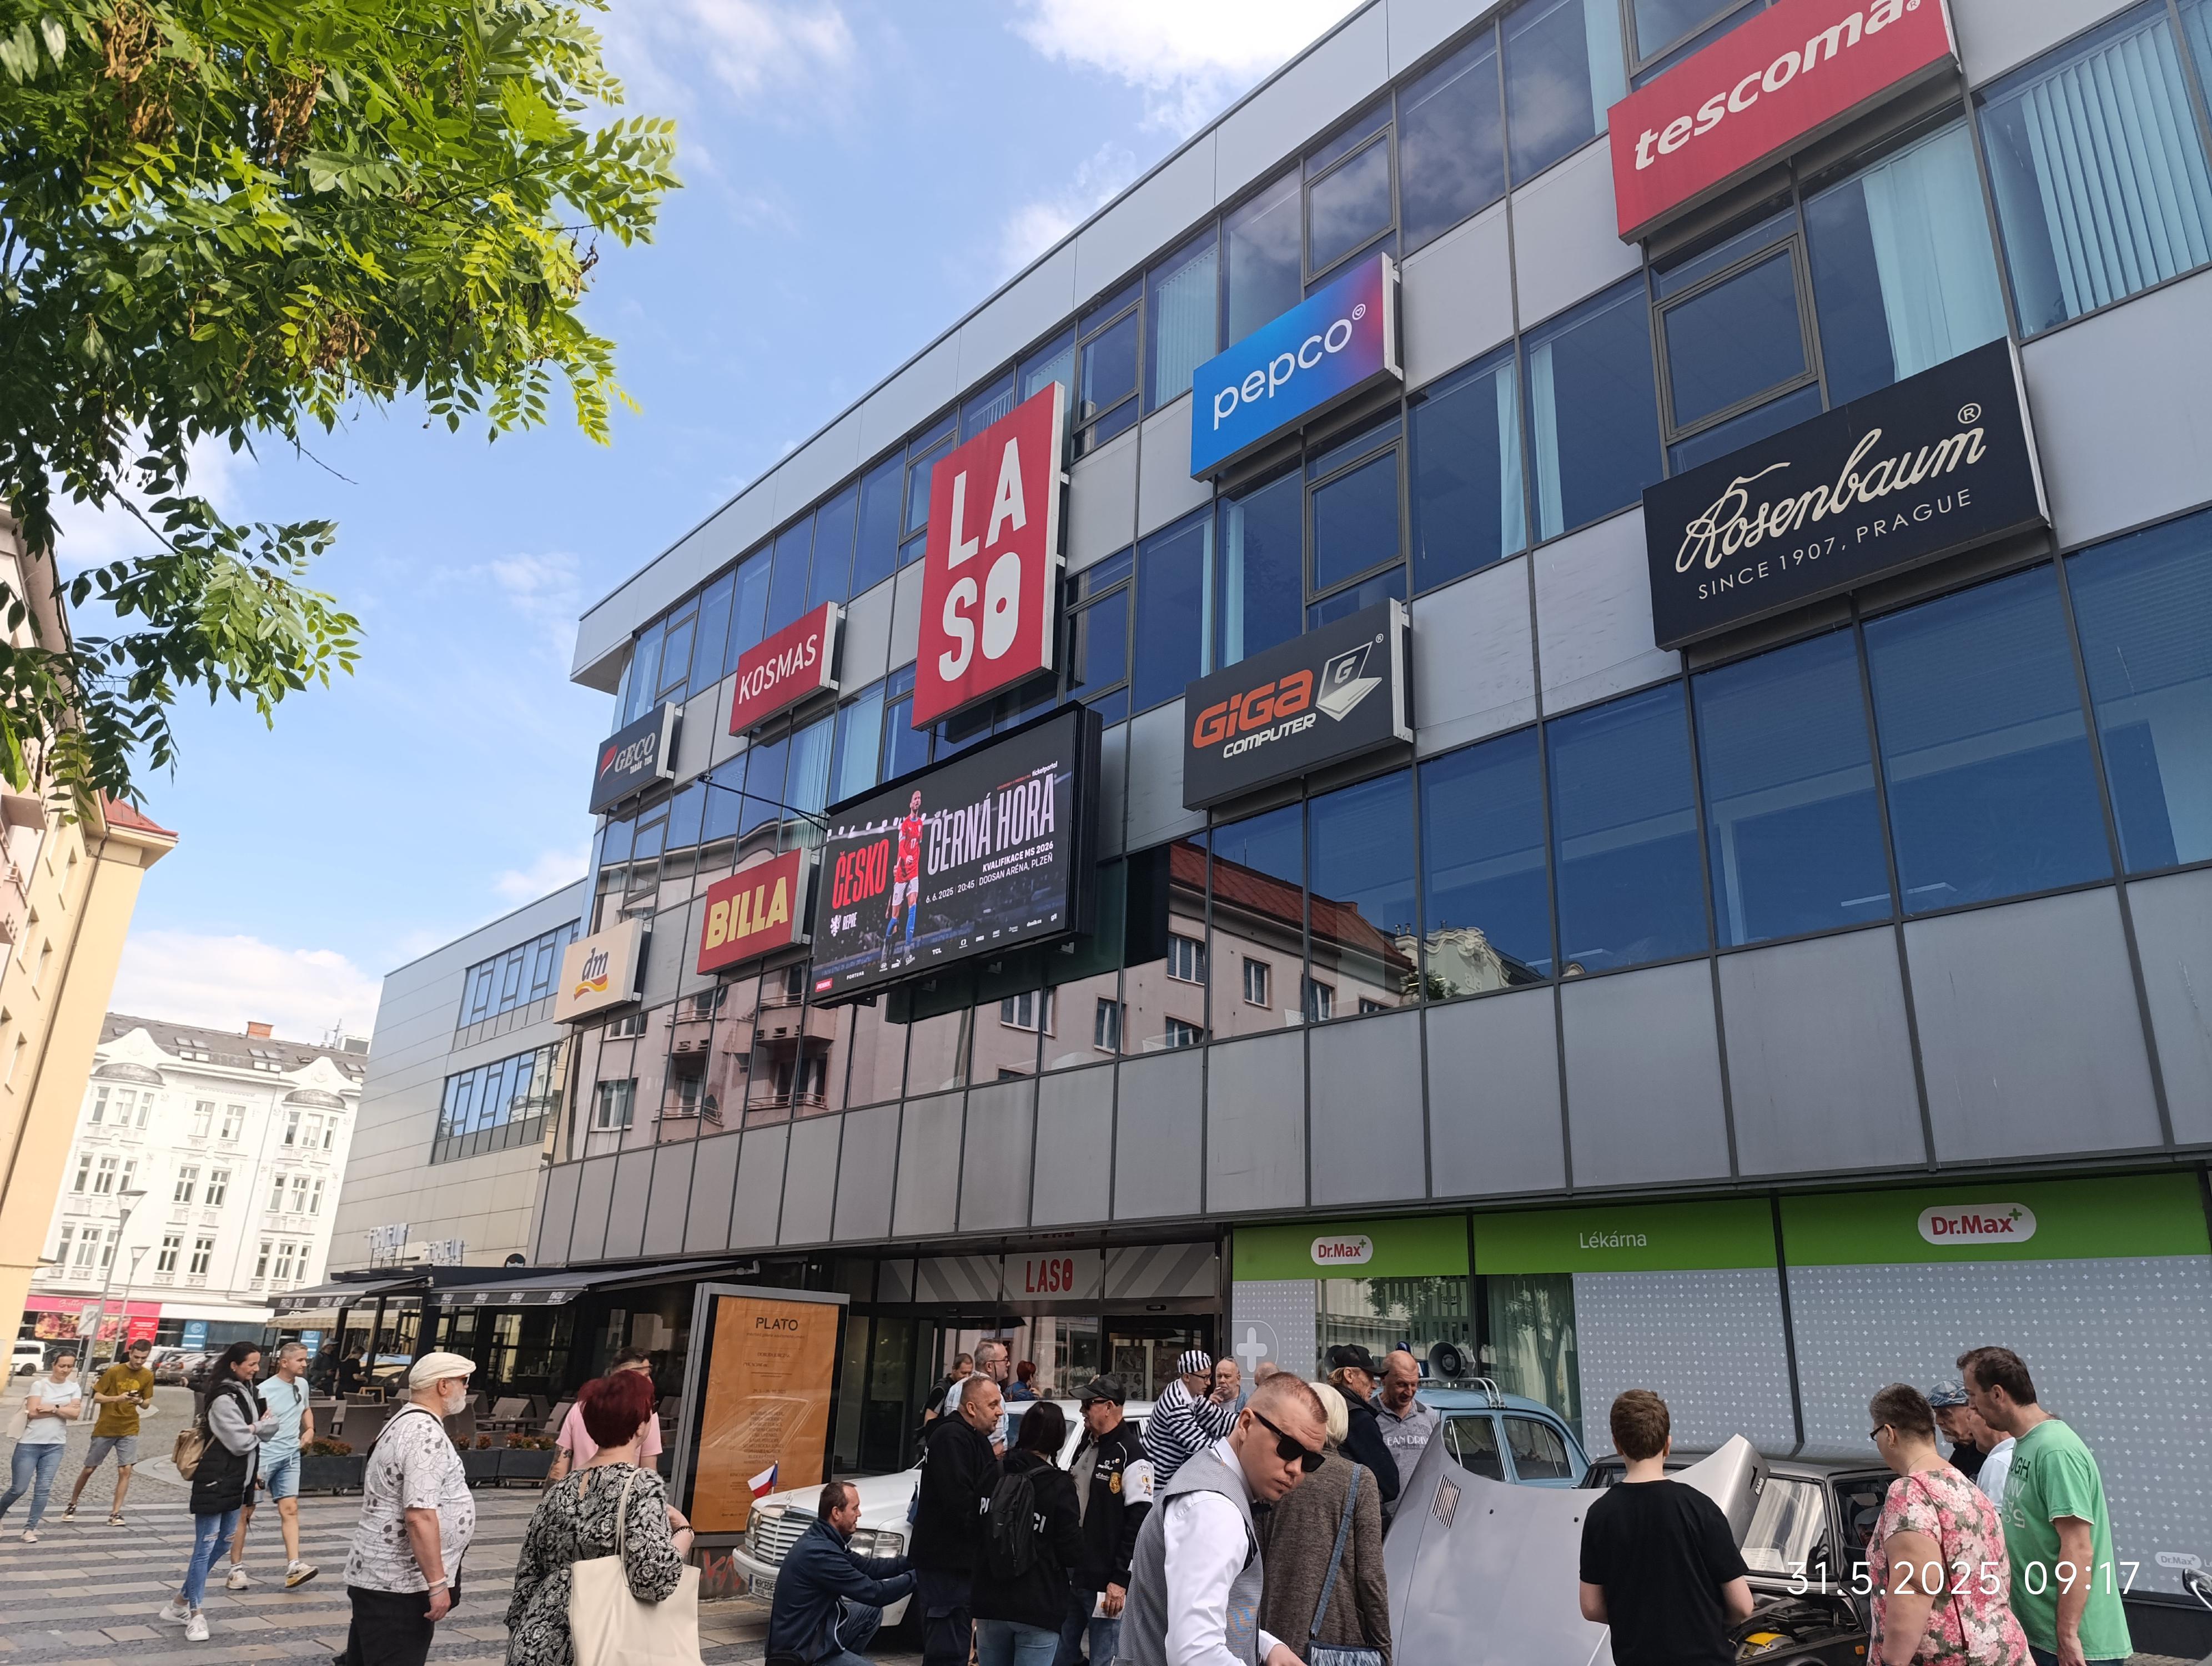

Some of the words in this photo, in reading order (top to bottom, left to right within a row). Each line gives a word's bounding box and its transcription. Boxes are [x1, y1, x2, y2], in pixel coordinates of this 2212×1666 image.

[1635, 0, 1903, 170] tescoma
[1213, 318, 1353, 430] pepco
[1675, 426, 1987, 573] Rosenbaum
[1698, 561, 1769, 600] SINCE
[1779, 536, 1846, 571] 1907,
[1856, 489, 1972, 544] PRAGUE
[738, 634, 818, 705] KOSMAS
[615, 732, 656, 772] GECO
[1223, 713, 1316, 759] COMPUTER
[1032, 761, 1057, 776] ticketportal
[927, 792, 991, 875] ČERNÁ
[996, 773, 1054, 851] HORA
[832, 839, 889, 910] ČESKO
[938, 887, 954, 899] 2025
[957, 880, 975, 894] 20:45
[979, 871, 1004, 886] DOOSAN
[1031, 852, 1053, 868] PLZEŇ
[982, 851, 1024, 872] KVALIFIKACE
[1025, 848, 1035, 859] MS
[1036, 841, 1054, 855] 2026
[705, 876, 788, 950] BILLA
[842, 912, 857, 931] REPRE
[582, 947, 609, 982] dm
[1579, 1230, 1647, 1250] Lékárna
[1025, 1258, 1073, 1293] LASO
[755, 1317, 799, 1331] PLATO
[1384, 1436, 1406, 1446] EAN
[1407, 1435, 1429, 1444] DRIV
[1755, 1477, 1764, 1496] SAAB
[2009, 1455, 2031, 1478] UGH
